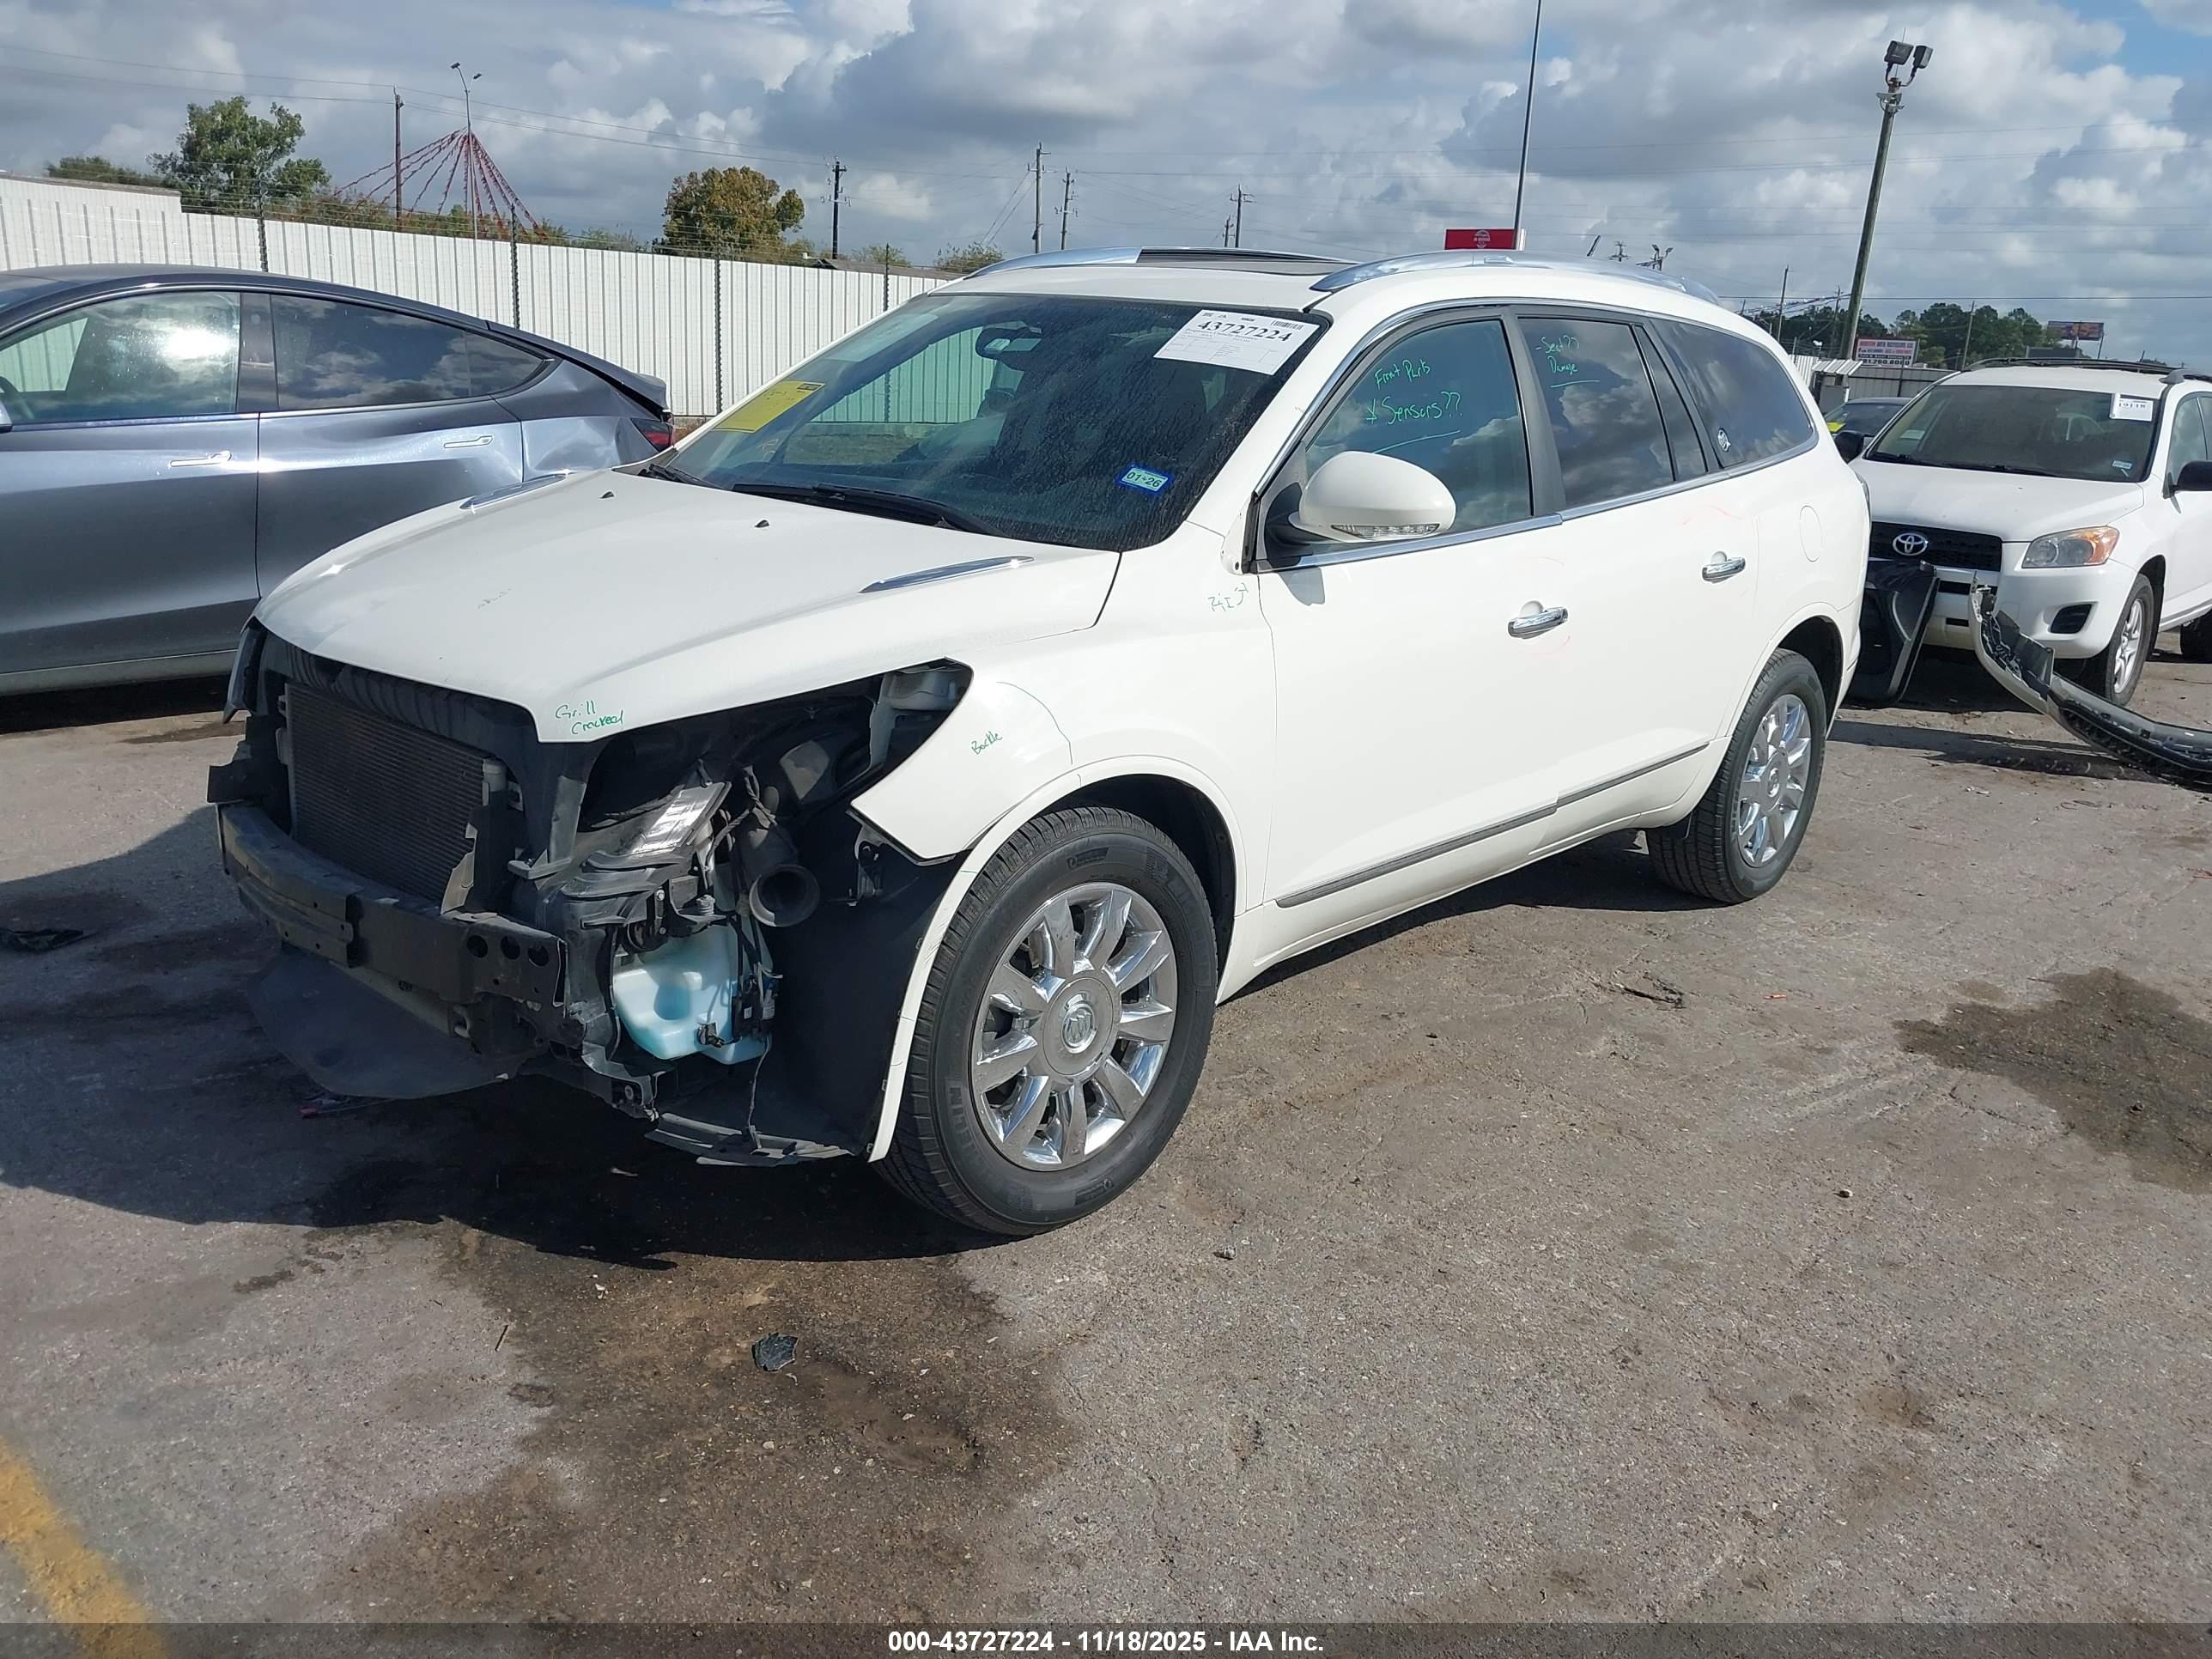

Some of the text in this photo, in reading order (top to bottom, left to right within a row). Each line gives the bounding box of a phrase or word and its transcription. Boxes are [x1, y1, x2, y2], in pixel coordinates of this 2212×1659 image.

[1198, 320, 1292, 341] 43727224
[1374, 359, 1431, 390] Front Parts
[555, 701, 596, 719] Grill
[572, 710, 623, 734] Cracked
